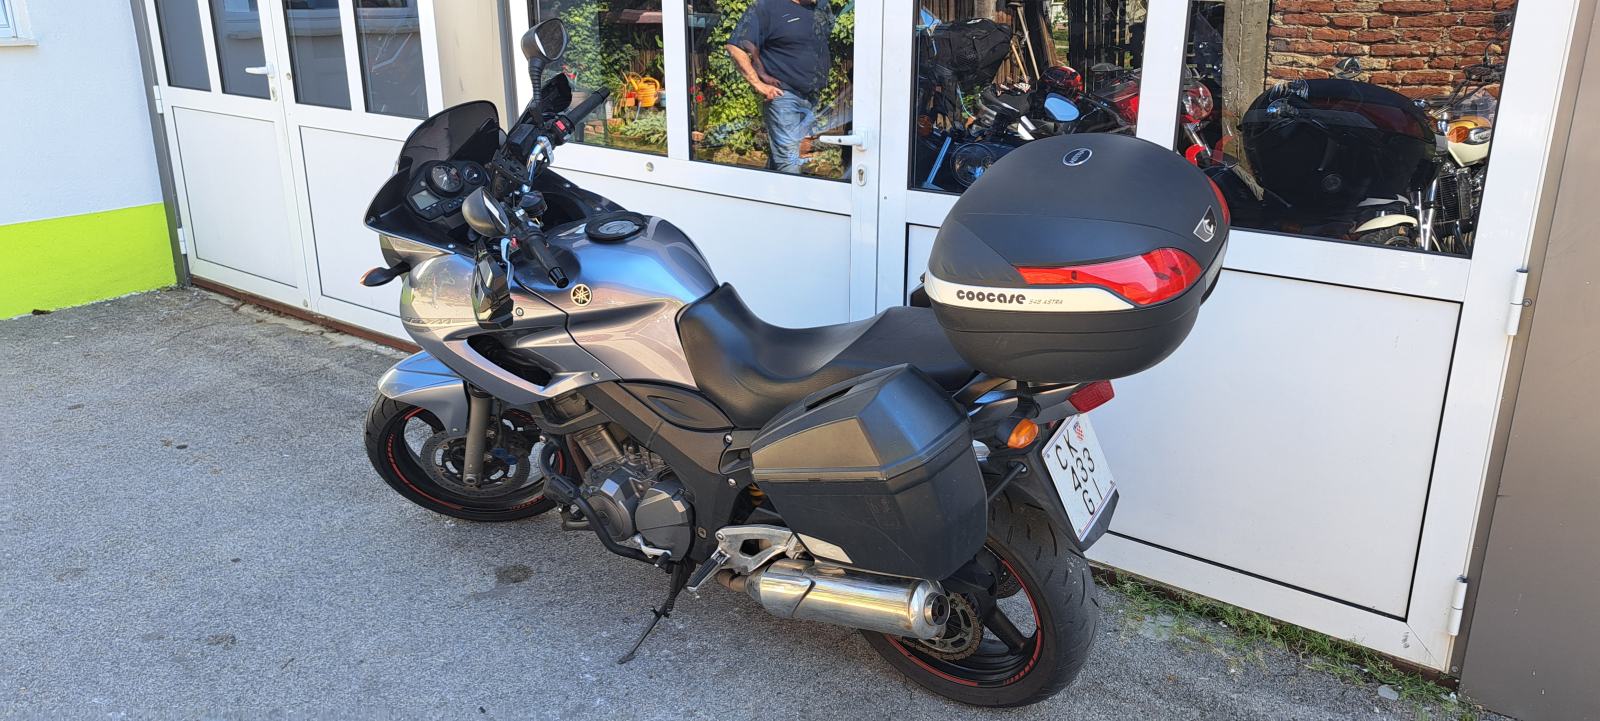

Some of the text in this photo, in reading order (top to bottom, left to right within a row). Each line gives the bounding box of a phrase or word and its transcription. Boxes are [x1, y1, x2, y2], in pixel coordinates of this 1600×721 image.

[1055, 430, 1078, 470] CK
[1070, 447, 1095, 492] 433
[1082, 477, 1103, 515] GI
